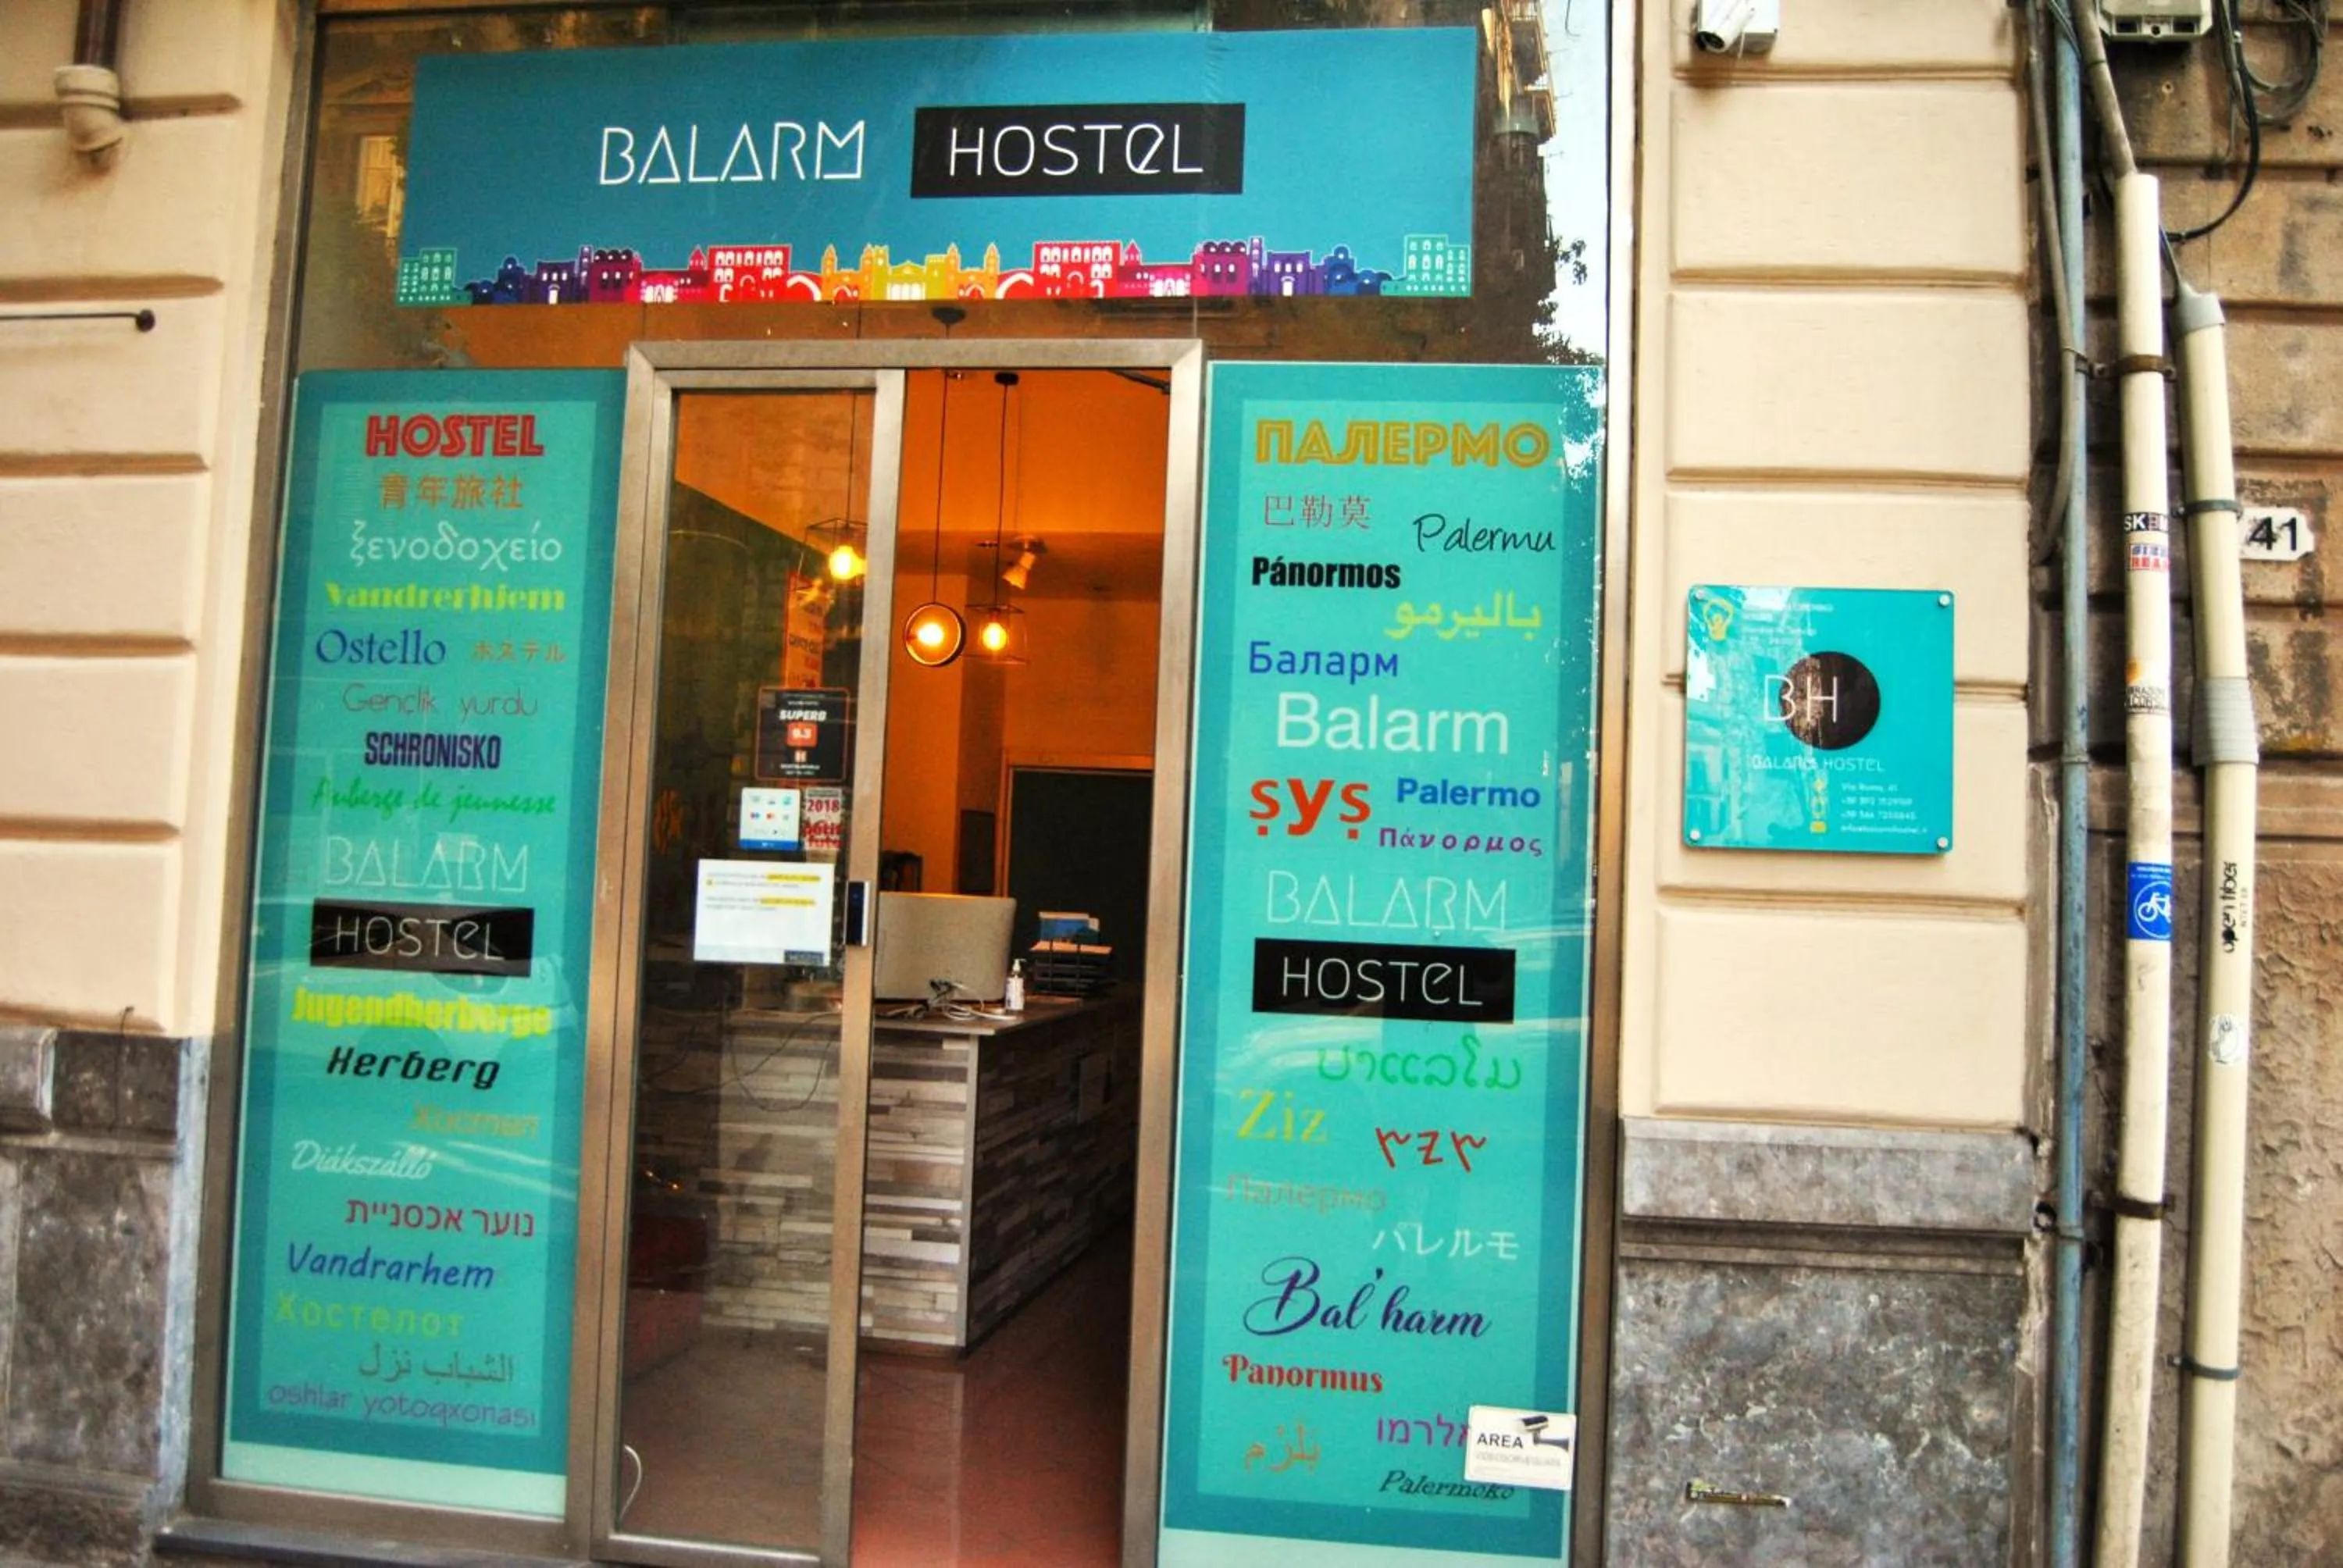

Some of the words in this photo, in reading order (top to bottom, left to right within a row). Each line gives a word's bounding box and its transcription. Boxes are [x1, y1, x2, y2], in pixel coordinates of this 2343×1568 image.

[600, 120, 865, 186] BALARM
[365, 414, 544, 457] HOSTEL
[1256, 419, 1550, 469] ПАЛЕРМО
[379, 472, 524, 510] 青年旅社
[1263, 494, 1371, 529] 巴勒莫
[350, 519, 562, 572] ξενοδοχείο
[1414, 513, 1557, 553] Palermu
[2248, 515, 2298, 551] 41
[1251, 555, 1401, 590] Pánormos
[1384, 590, 1542, 640] باليرمو
[316, 629, 447, 665] Ostello
[473, 640, 566, 664] ホステル
[1250, 640, 1399, 685] Баларм
[460, 686, 538, 723] yurdu
[779, 708, 828, 722] SUPERB
[1277, 691, 1508, 755] Balarm
[365, 731, 501, 769] SCHRONISKO
[413, 782, 441, 810] de
[448, 785, 557, 825] jeunesse
[807, 799, 840, 813] 2018
[1396, 776, 1541, 808] Palermo
[1378, 828, 1542, 857] Πάνορμος
[324, 836, 529, 892] BALARM
[1267, 870, 1507, 932] BALARM
[292, 986, 551, 1039] Jugendherberge
[326, 1046, 500, 1090] Herberg
[1235, 1089, 1327, 1143] Ziz
[1225, 1173, 1387, 1214] Палермо
[345, 1198, 463, 1231] אכסניית
[471, 1208, 535, 1237] נוער
[1372, 1221, 1519, 1261] パレルモ
[288, 1242, 495, 1288] Vandrarhem
[358, 1342, 412, 1383] نزل
[423, 1352, 515, 1386] الشباب
[1222, 1353, 1383, 1394] Panormus
[1476, 1432, 1524, 1449] AREA
[1378, 1469, 1515, 1500] Palermoko
